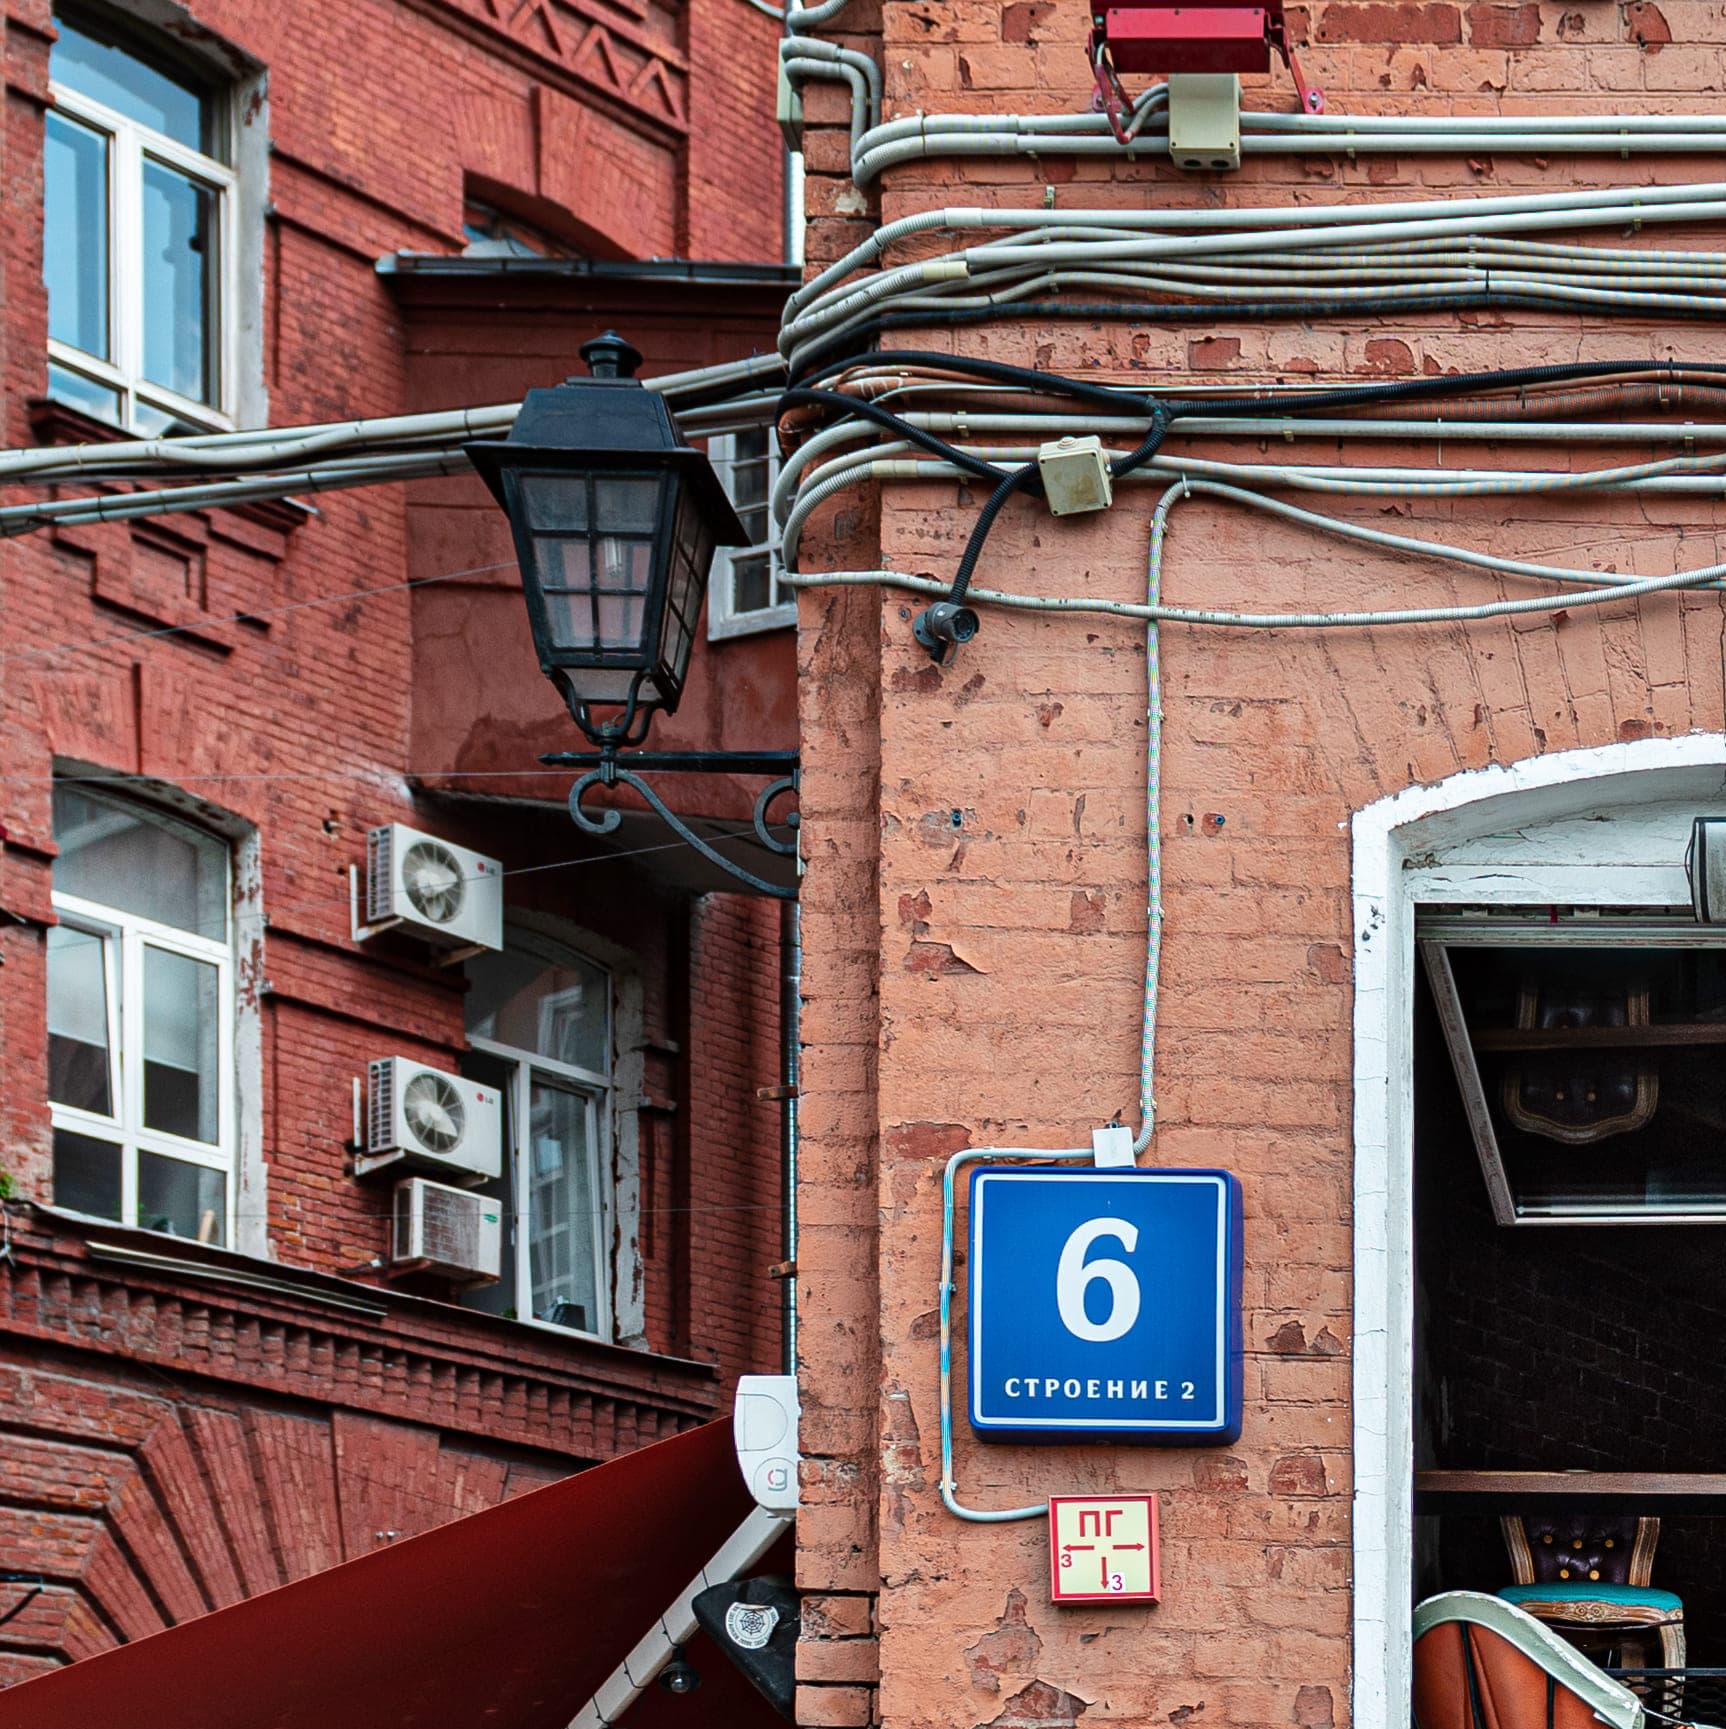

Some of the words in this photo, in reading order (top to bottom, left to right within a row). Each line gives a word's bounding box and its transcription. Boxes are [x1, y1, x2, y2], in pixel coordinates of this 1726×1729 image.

[1056, 1217, 1141, 1343] 6
[1004, 1377, 1169, 1401] СТРОЕНИЕ
[1180, 1381, 1196, 1400] 2
[1079, 1509, 1124, 1538] ПГ
[1061, 1554, 1073, 1568] 3
[1112, 1574, 1123, 1591] 3
